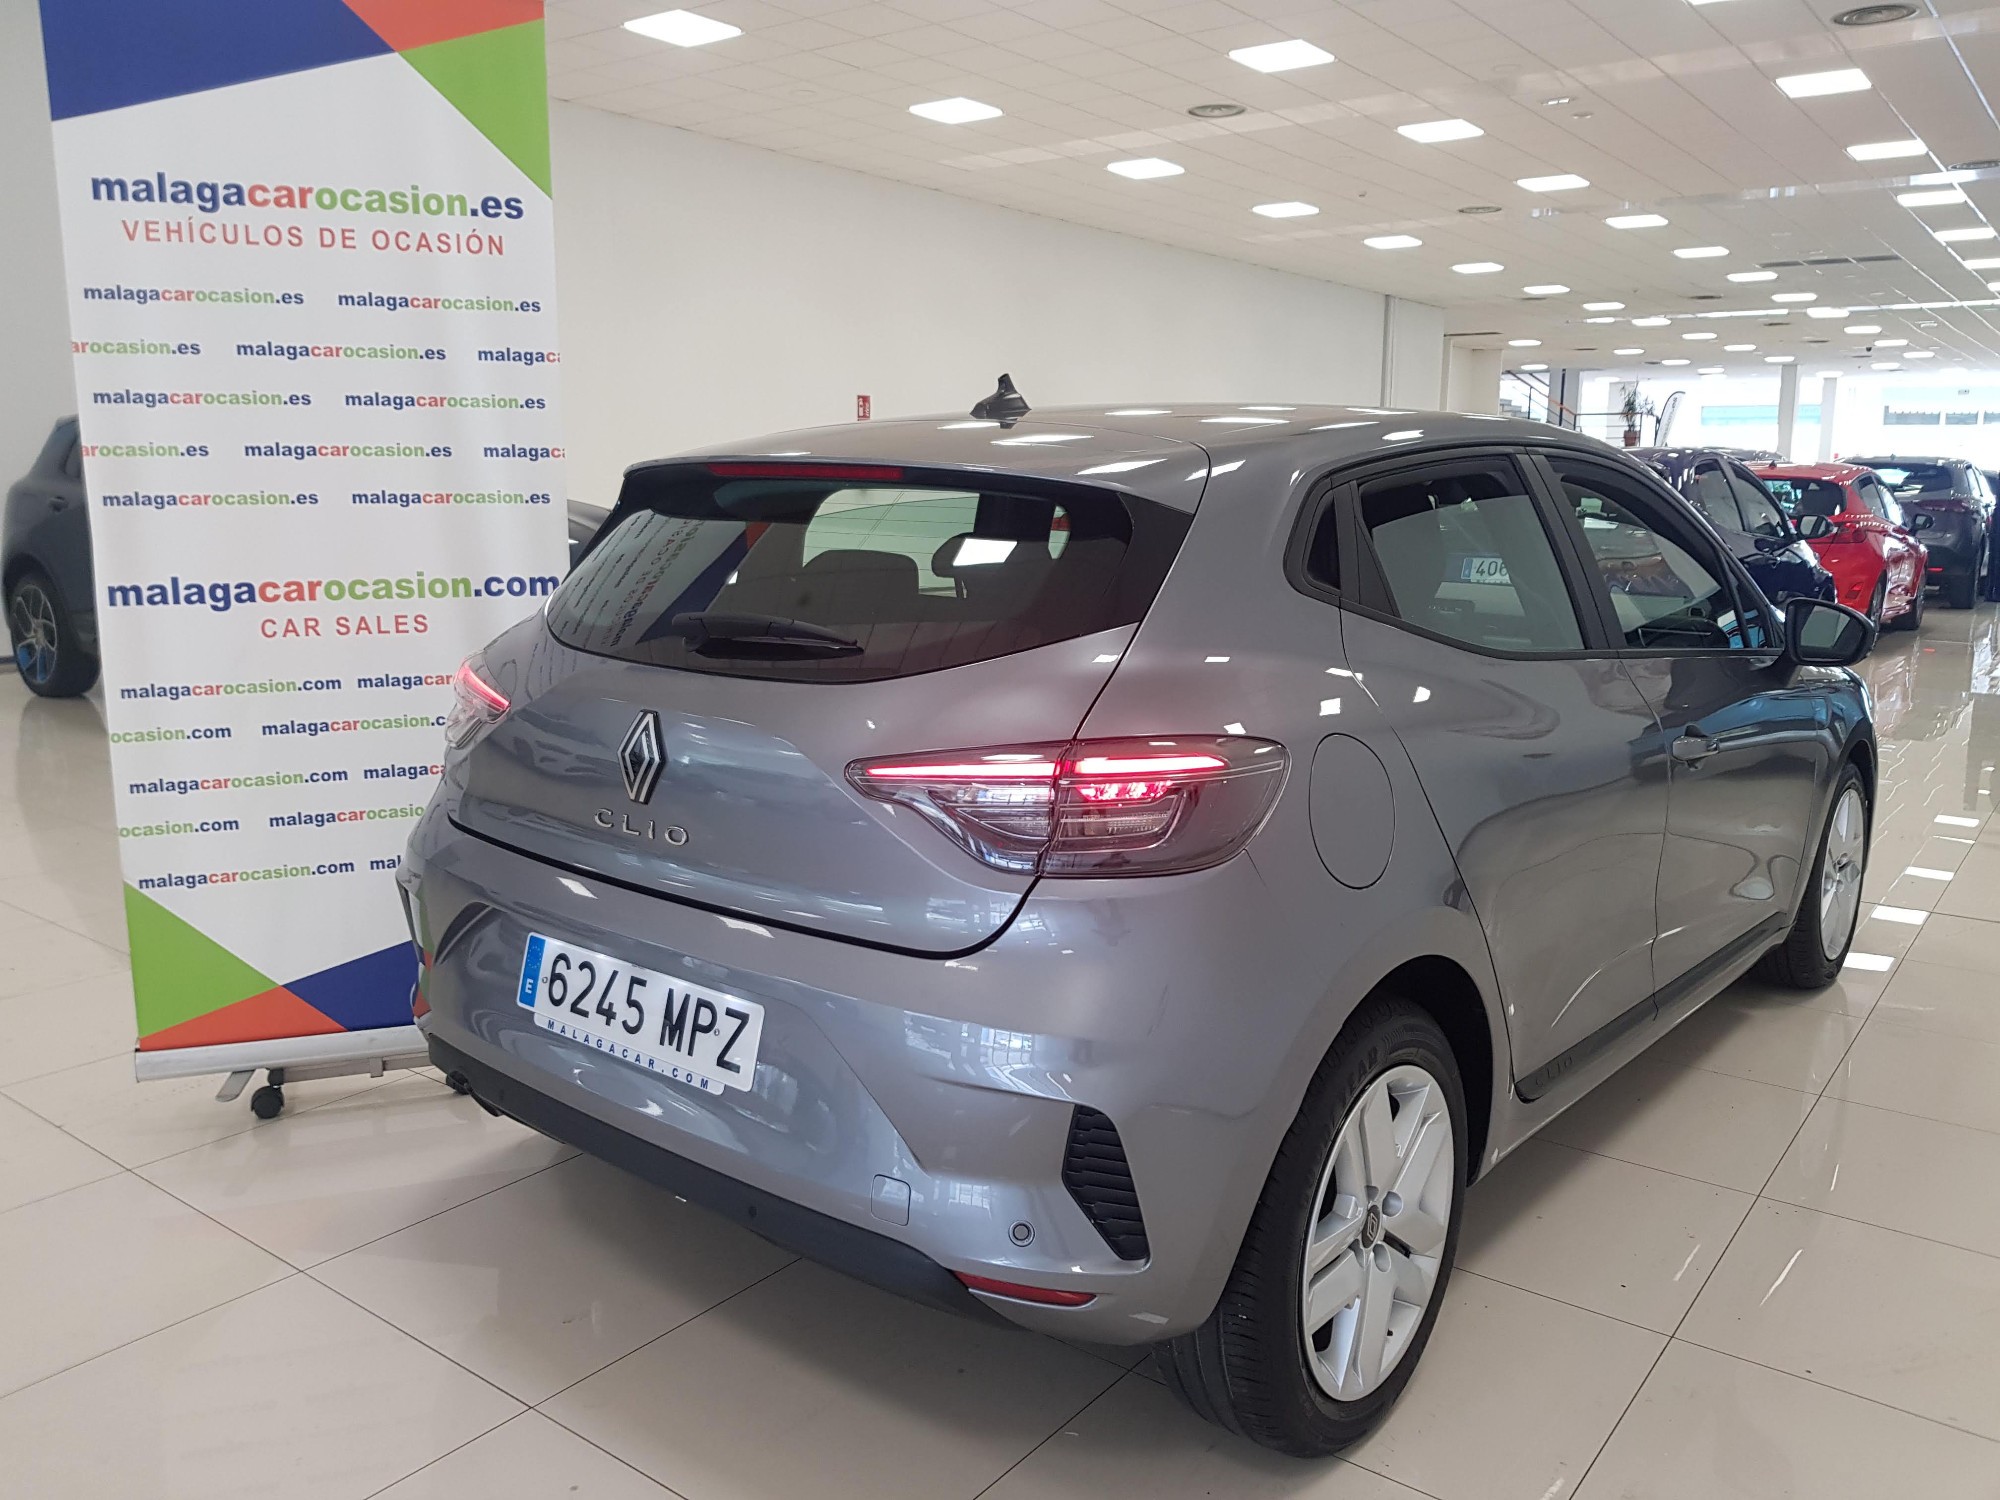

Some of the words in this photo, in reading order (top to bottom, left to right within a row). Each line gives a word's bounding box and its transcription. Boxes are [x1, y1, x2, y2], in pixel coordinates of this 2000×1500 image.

[91, 172, 524, 219] malagacarocasion.es
[122, 217, 302, 247] VEHÍCULOS
[320, 228, 356, 249] DE
[372, 229, 503, 255] OCASIÓN
[84, 285, 304, 304] malagacarocasion.es
[338, 292, 541, 312] malagacarocasion.es
[237, 341, 446, 360] malagacarocasion.es
[93, 389, 311, 408] malagacarocasion.es
[345, 392, 545, 410] malagacarocasion.es
[245, 442, 452, 460] malagacarocasion.es
[103, 491, 318, 509] malagacarocasion.es
[352, 490, 550, 507] malagacarocasion.es
[108, 571, 560, 612] malagacarocasion.com
[261, 618, 320, 638] CAR
[336, 614, 428, 635] SALES
[120, 676, 342, 700] malagacarocasion.com
[110, 723, 232, 743] ocasion.com
[129, 767, 348, 795] malagacarocasion.com
[119, 816, 240, 838] ocasion.com
[594, 808, 689, 846] CLIO
[138, 858, 355, 890] malagacarocasion.com
[524, 978, 534, 994] E
[548, 952, 648, 1035] 6245
[659, 987, 750, 1075] MPZ
[547, 1018, 709, 1090] MALAGACAR.COM
